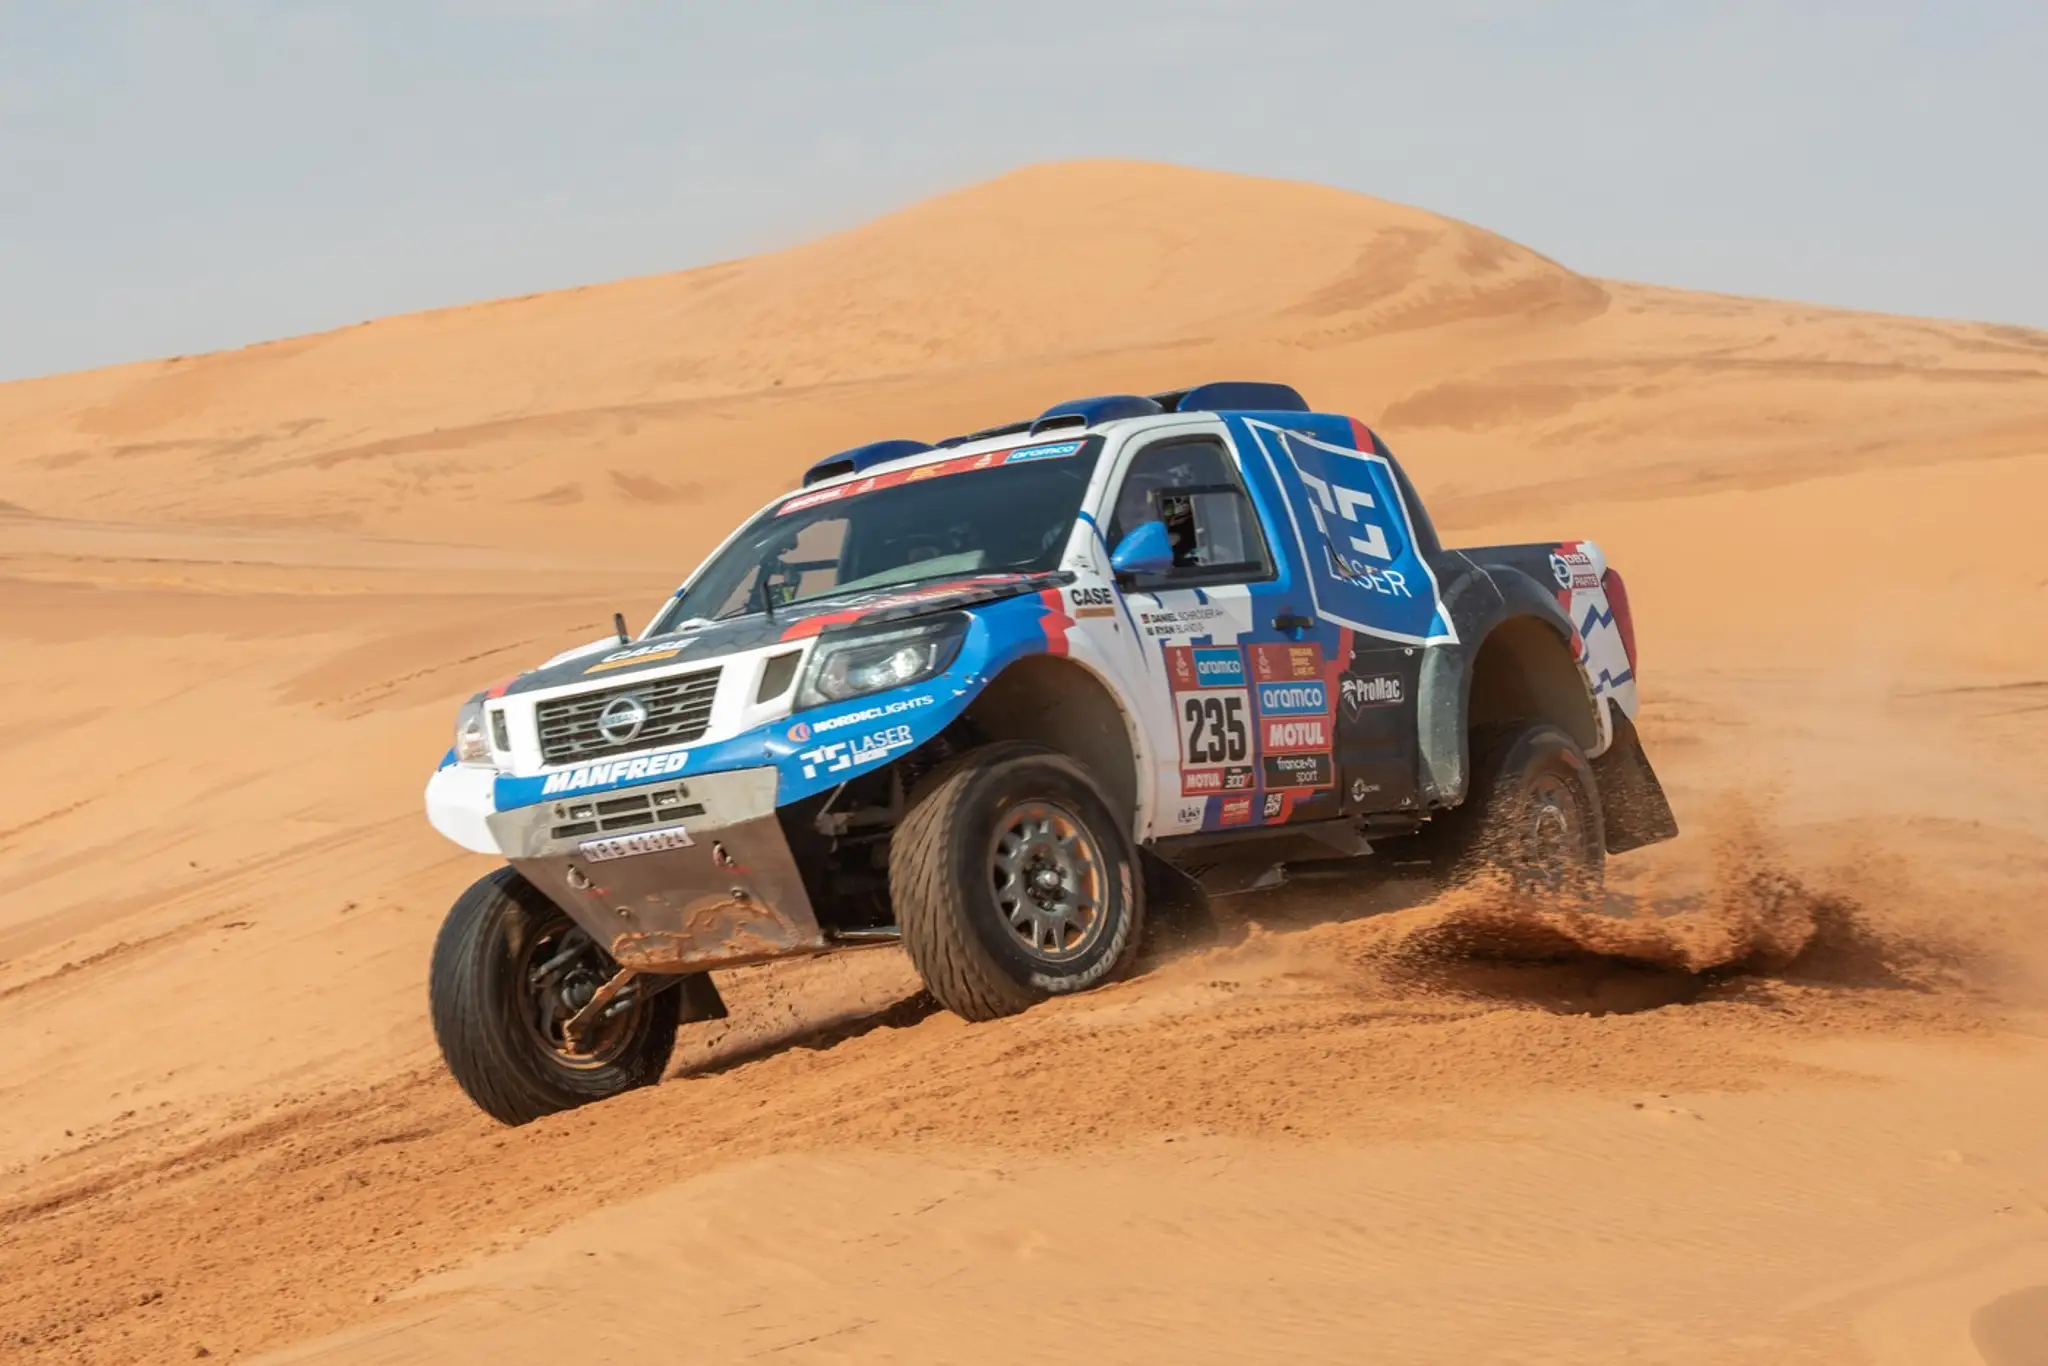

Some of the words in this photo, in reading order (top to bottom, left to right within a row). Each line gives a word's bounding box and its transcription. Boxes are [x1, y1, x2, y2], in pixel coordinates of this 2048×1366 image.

[1011, 445, 1076, 459] aramco
[1071, 587, 1113, 606] CASE
[1155, 625, 1175, 636] RYAN
[1198, 660, 1241, 674] aramco
[1263, 688, 1323, 708] aramco
[1355, 677, 1401, 701] ProMac
[850, 725, 912, 755] LASER
[1185, 697, 1247, 764] 235
[1269, 723, 1325, 747] MOTUL
[542, 752, 689, 795] MANFRED
[1186, 773, 1221, 788] MOTUL
[1295, 772, 1319, 786] sport
